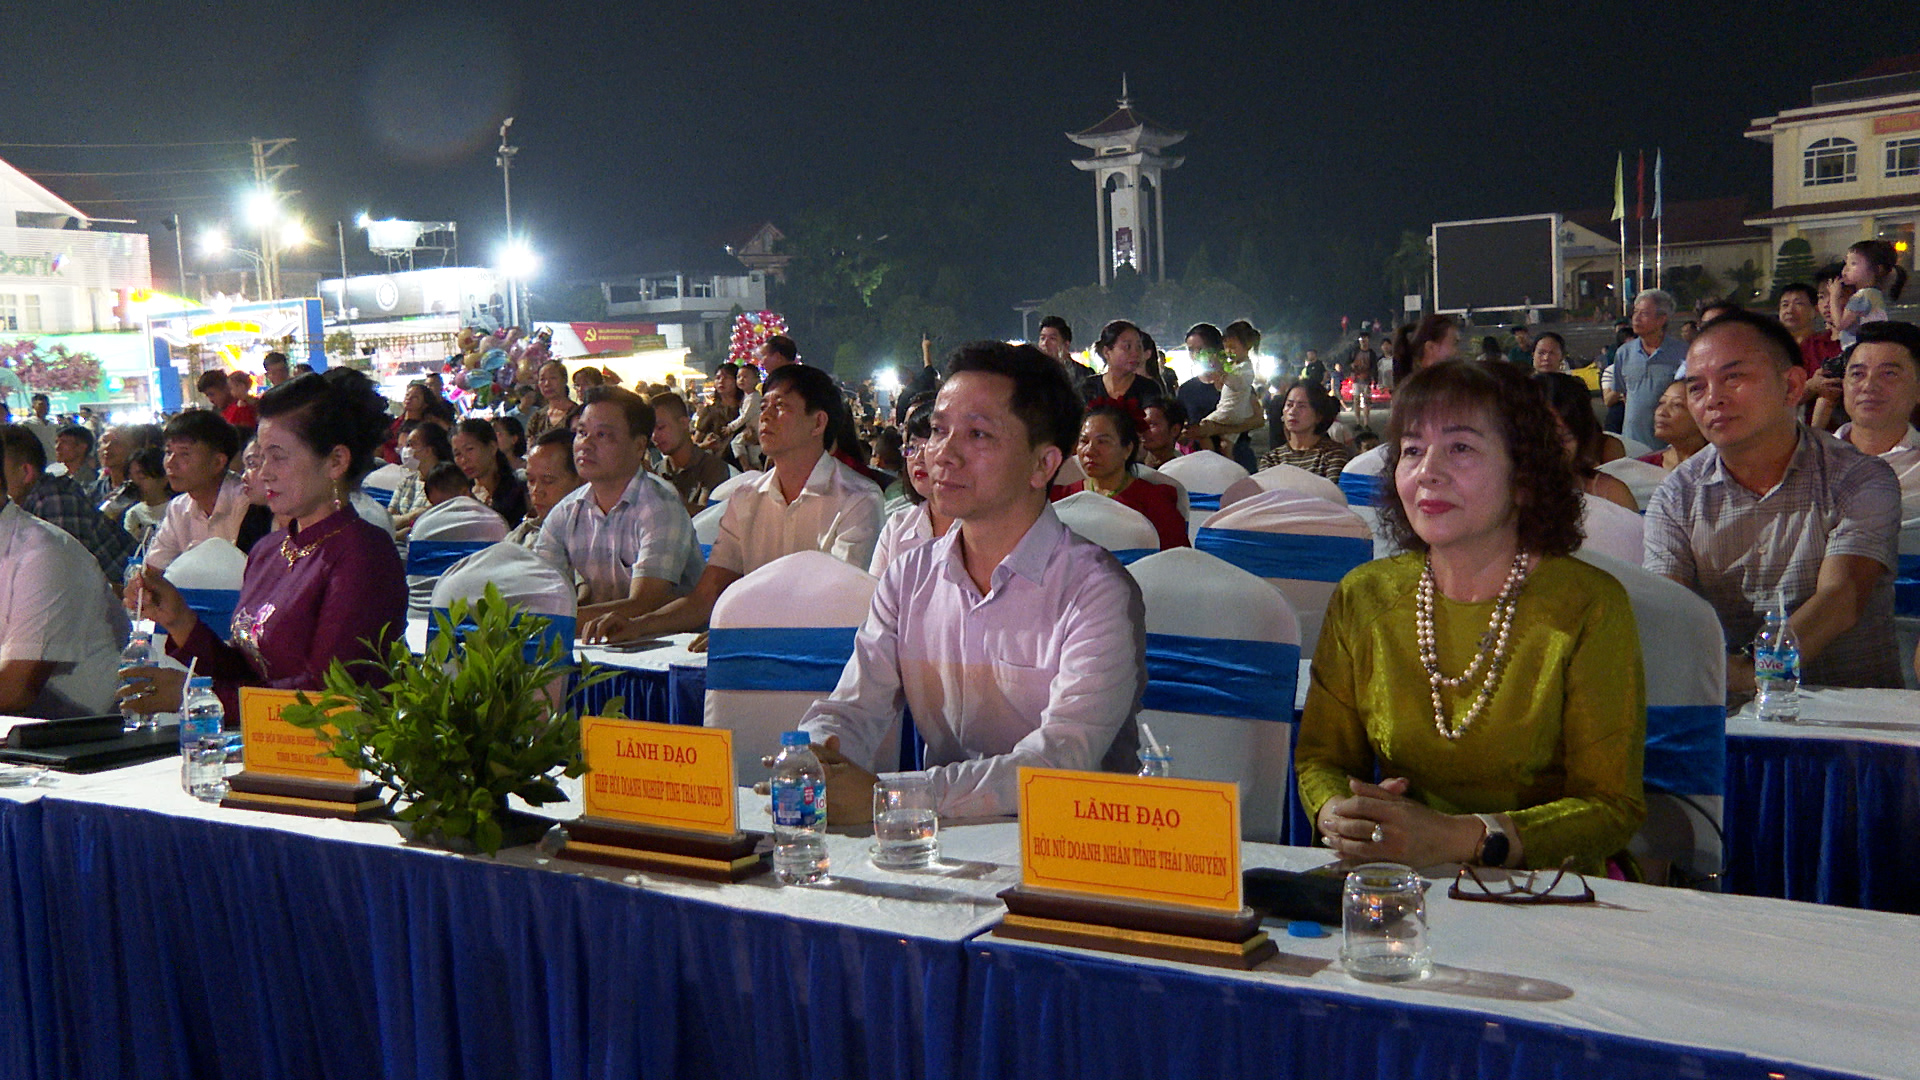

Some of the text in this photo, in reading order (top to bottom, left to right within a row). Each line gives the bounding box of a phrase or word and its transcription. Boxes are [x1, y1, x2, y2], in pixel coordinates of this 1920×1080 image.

[616, 737, 697, 768] LÃNH ĐẠO
[1073, 797, 1180, 832] LÃNH ĐẠO
[1034, 832, 1228, 877] HỘI NỮ DOANH NHÂN TỈNH THÁI NGUYÊN
